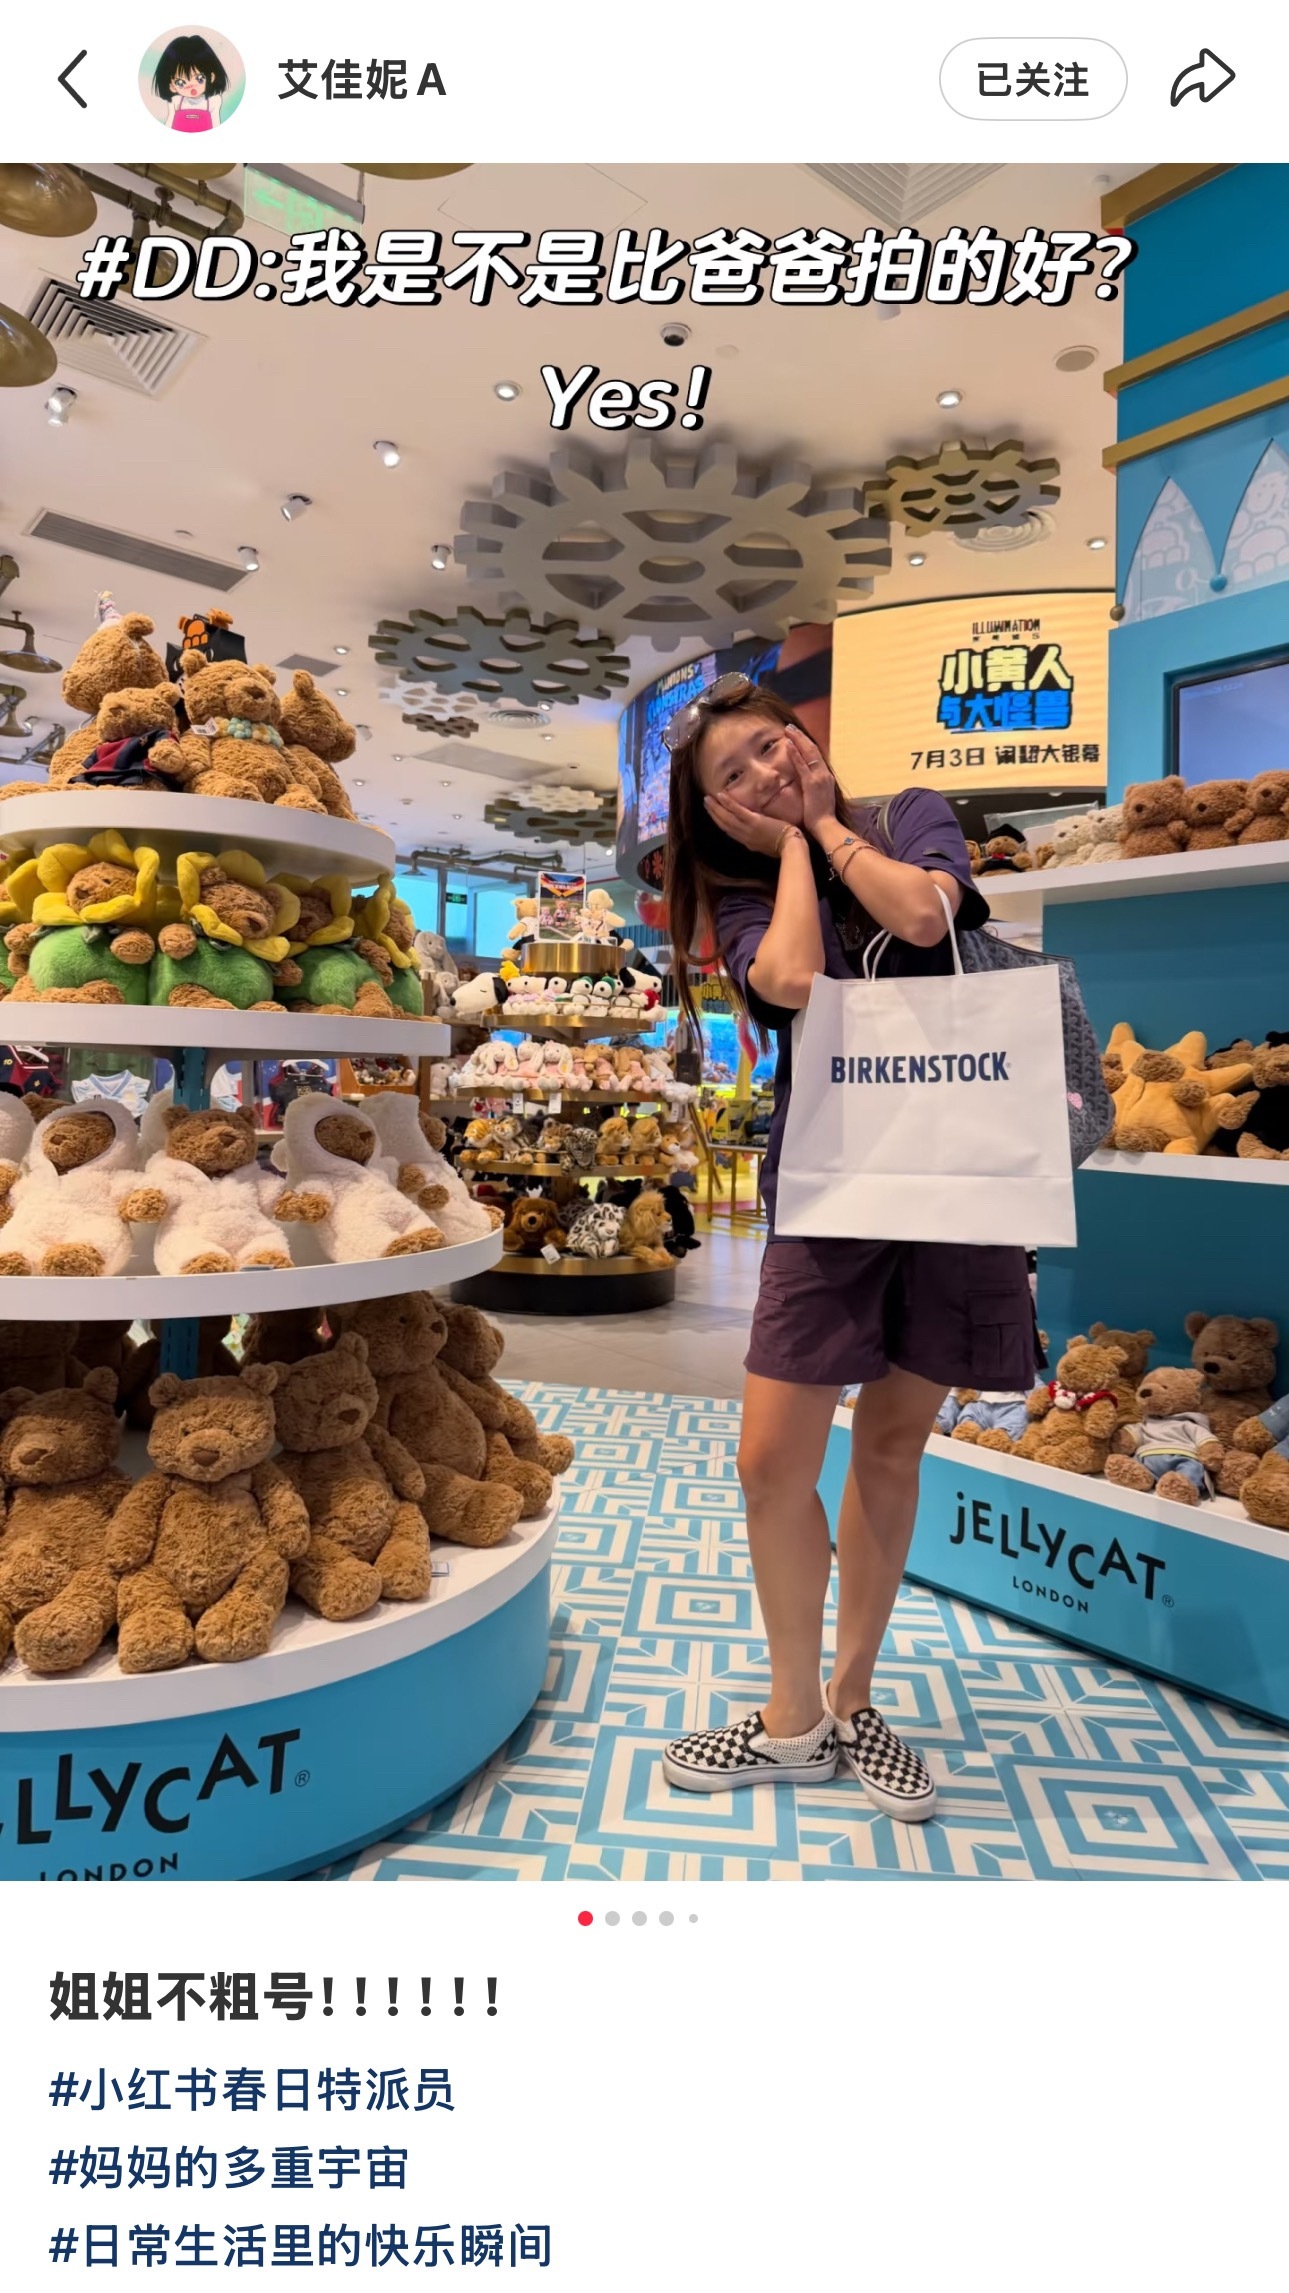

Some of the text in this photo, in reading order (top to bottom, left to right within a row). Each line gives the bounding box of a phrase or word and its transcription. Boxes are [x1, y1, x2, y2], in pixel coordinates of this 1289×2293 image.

[939, 645, 1074, 696] 小黄人
[938, 690, 1072, 732] 与大怪兽
[910, 747, 985, 771] 7月3日
[831, 1051, 1009, 1084] BIRKENSTOCK
[1012, 1575, 1089, 1614] LONDON
[0, 1728, 301, 1845] LLYCAT
